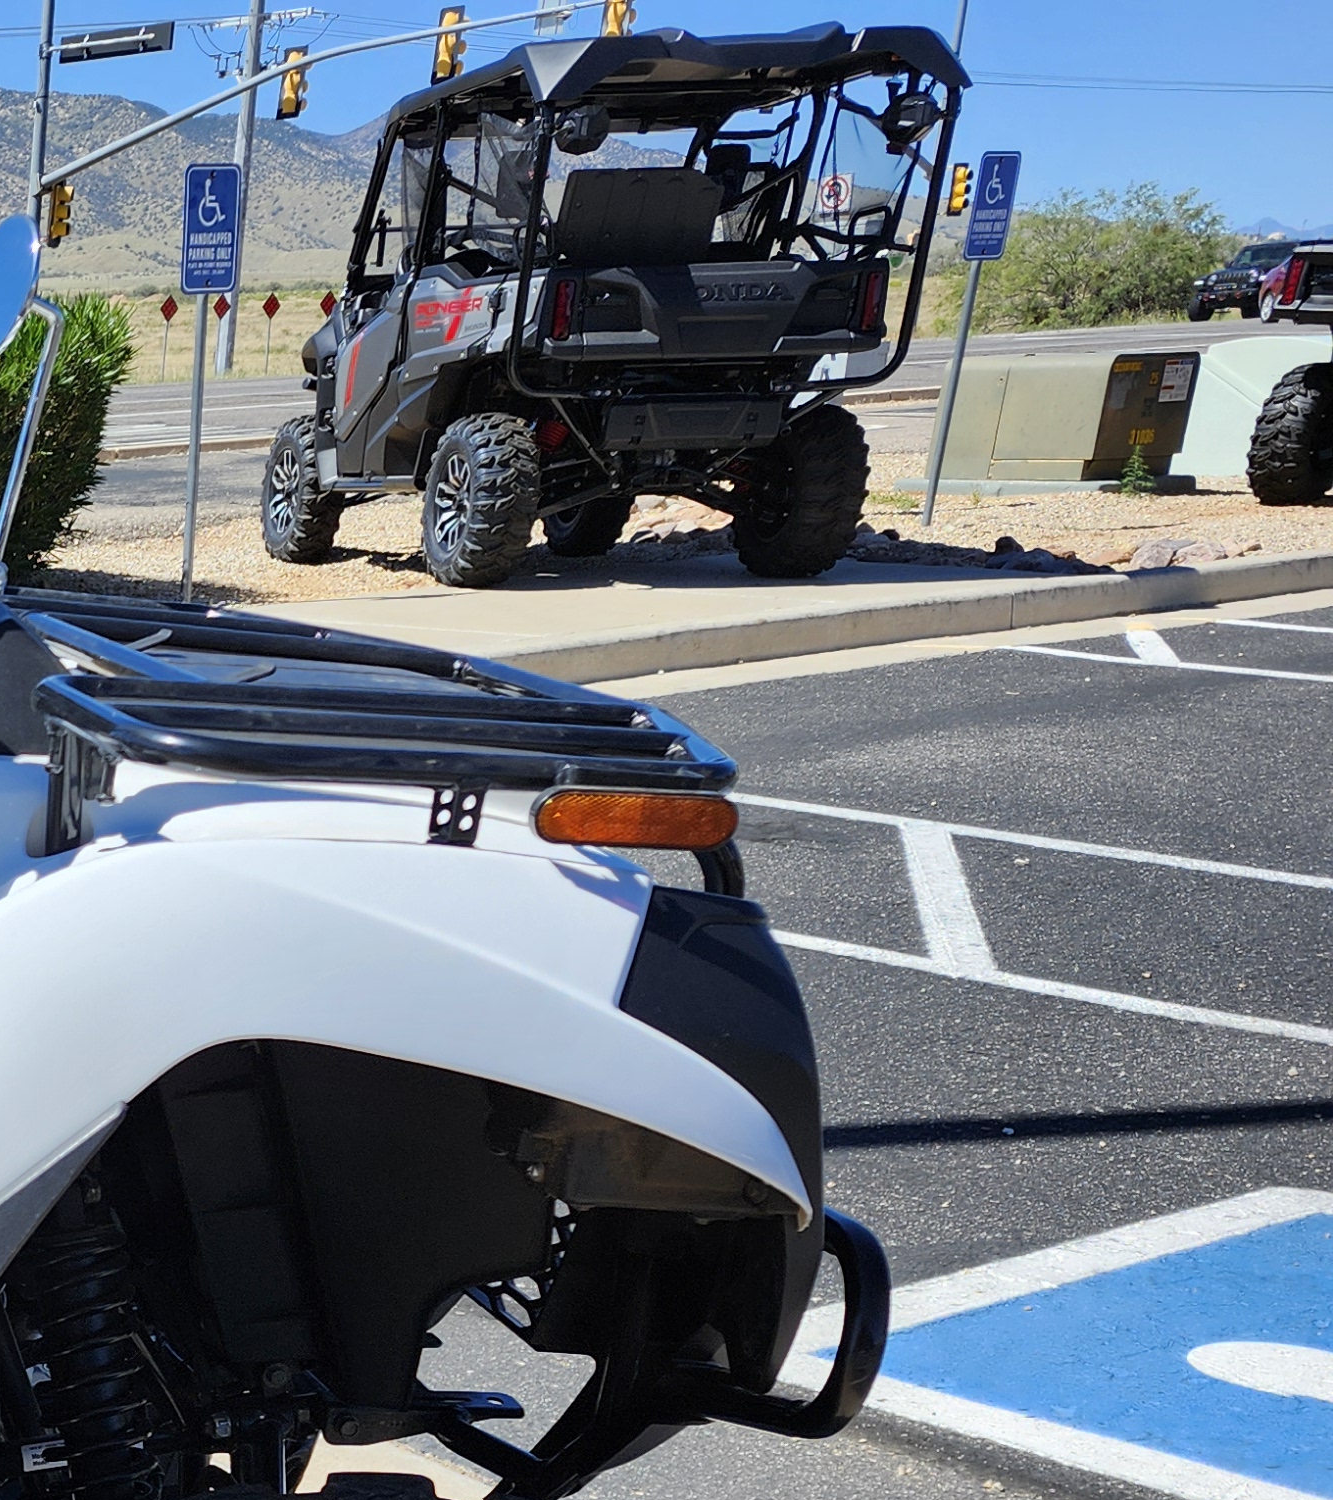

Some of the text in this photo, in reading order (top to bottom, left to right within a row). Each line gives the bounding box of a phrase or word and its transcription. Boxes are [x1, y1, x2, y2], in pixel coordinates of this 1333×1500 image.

[190, 232, 232, 245] HANDICAPPED
[188, 247, 232, 260] PARKING ONLY
[694, 282, 795, 301] ONDA
